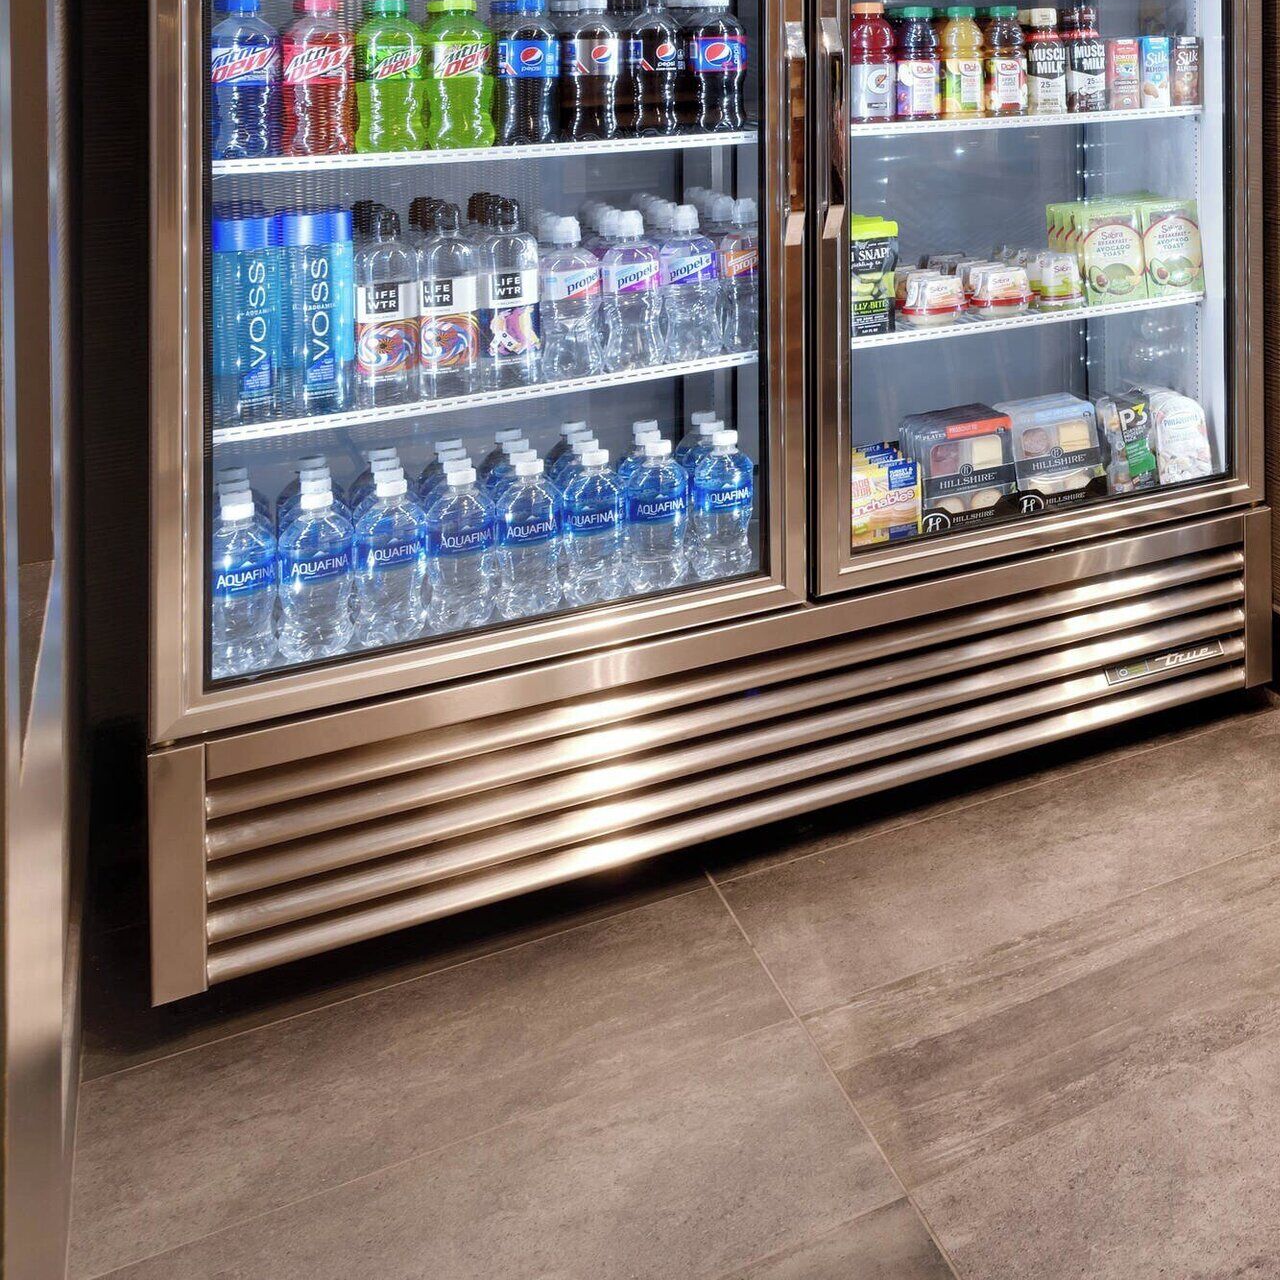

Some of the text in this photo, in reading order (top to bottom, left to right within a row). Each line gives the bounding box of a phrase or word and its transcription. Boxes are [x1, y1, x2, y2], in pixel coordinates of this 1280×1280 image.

[657, 60, 676, 68] pepsi
[1146, 50, 1168, 67] Silk
[1176, 50, 1199, 66] Silk
[1036, 60, 1064, 75] MILK
[1040, 81, 1051, 89] 25
[1101, 231, 1124, 240] Sabra
[1097, 244, 1131, 253] AVOCADO
[617, 264, 653, 289] propel
[669, 256, 706, 281] propel
[494, 275, 521, 286] LIFE
[494, 286, 521, 295] WTR
[311, 257, 330, 361] VOSS
[368, 299, 396, 310] WTR
[249, 261, 268, 367] VOSS
[1119, 403, 1147, 431] P3
[1032, 455, 1085, 471] HILLSHIRE
[939, 474, 996, 490] HILLSHIRE
[706, 486, 750, 504] AQUAFINA
[1046, 492, 1086, 505] HILLSHIRE
[637, 497, 685, 517] AQUAFINA
[567, 509, 615, 527] AQUAFINA
[952, 510, 995, 524] HILLSHIRE
[507, 518, 558, 538] AQUAFINA
[440, 526, 492, 550] AQUAFINA
[368, 541, 421, 563] AQUAFINA
[291, 553, 349, 577] AQUAFINA
[216, 565, 275, 590] AQUAFINA
[1155, 647, 1215, 667] true
